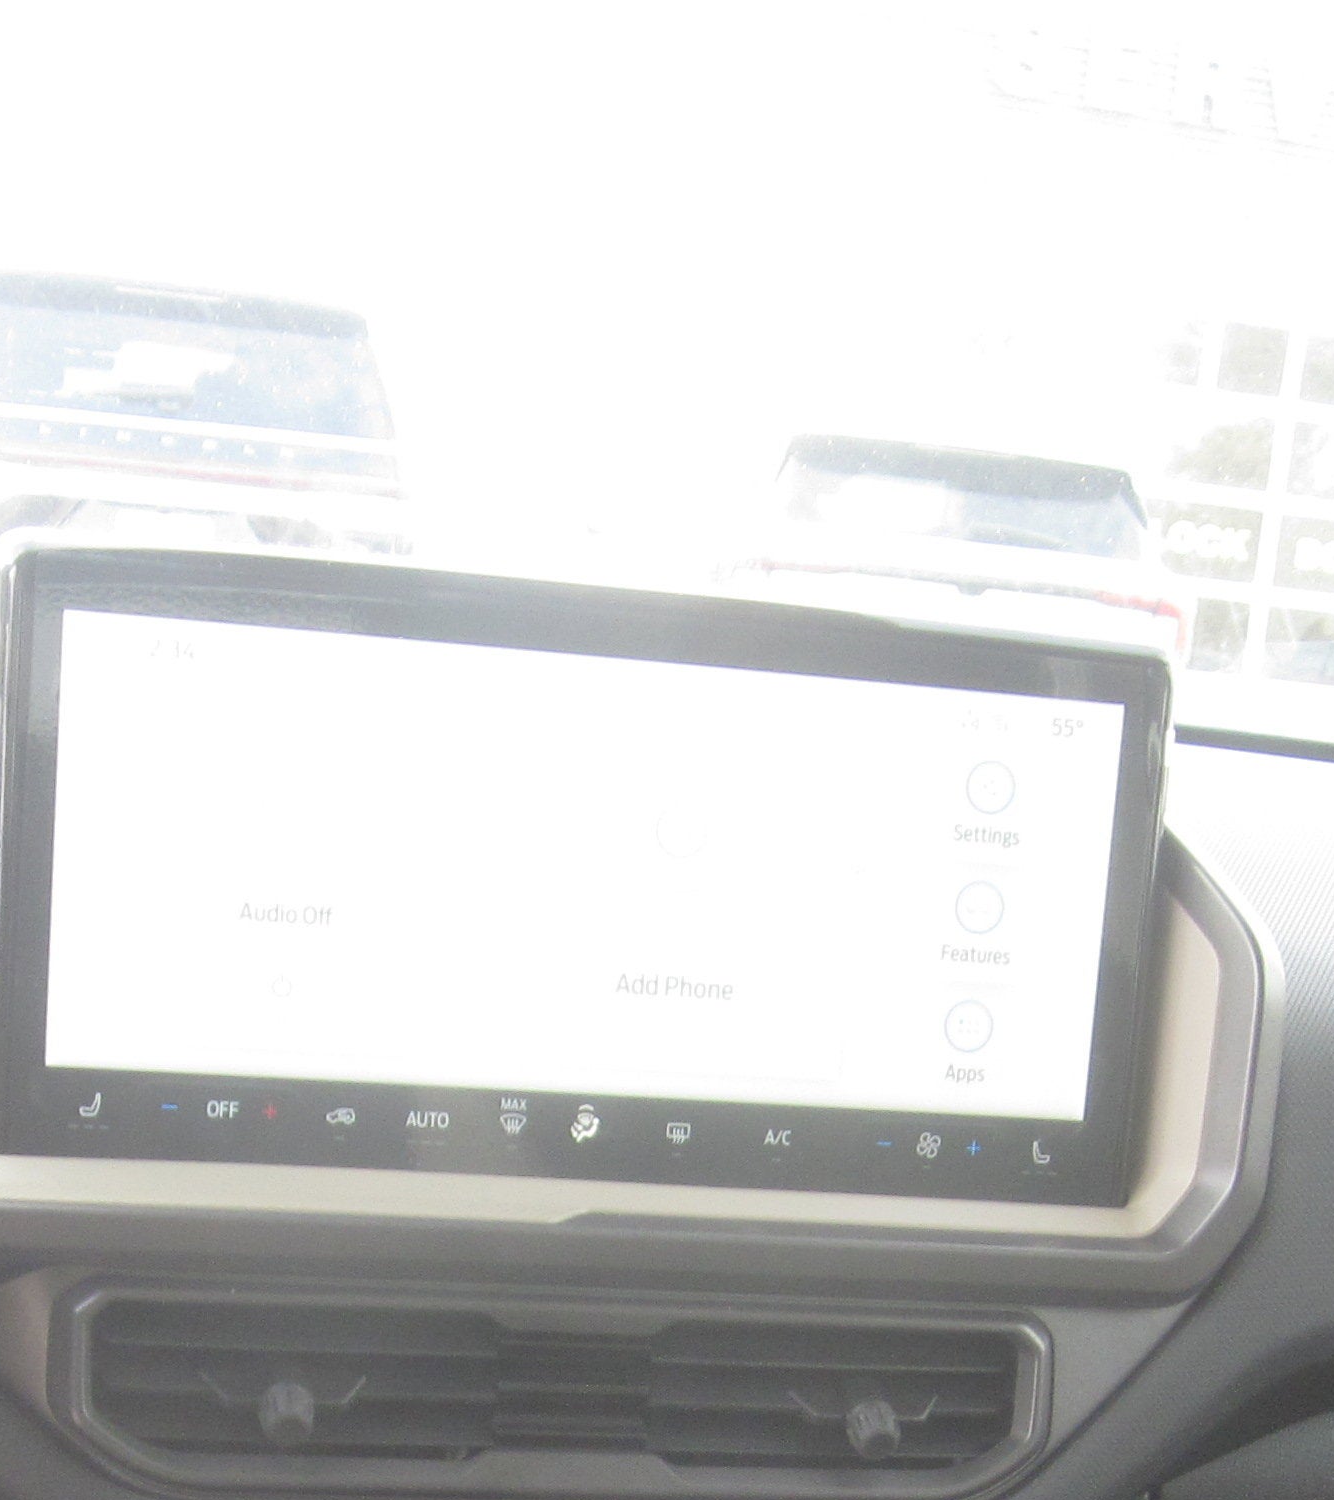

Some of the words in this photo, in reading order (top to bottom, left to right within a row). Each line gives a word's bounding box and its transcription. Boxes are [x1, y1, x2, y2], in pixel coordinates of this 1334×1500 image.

[953, 823, 1022, 850] Settings
[239, 901, 296, 927] Audio
[301, 905, 333, 927] Off
[940, 943, 1011, 967] Features
[615, 972, 660, 997] Add
[666, 974, 734, 1001] Phone
[944, 1062, 986, 1085] Apps
[206, 1100, 239, 1118] OFF
[500, 1097, 527, 1111] MAX
[405, 1110, 450, 1129] AUTO
[763, 1128, 791, 1147] A/C
